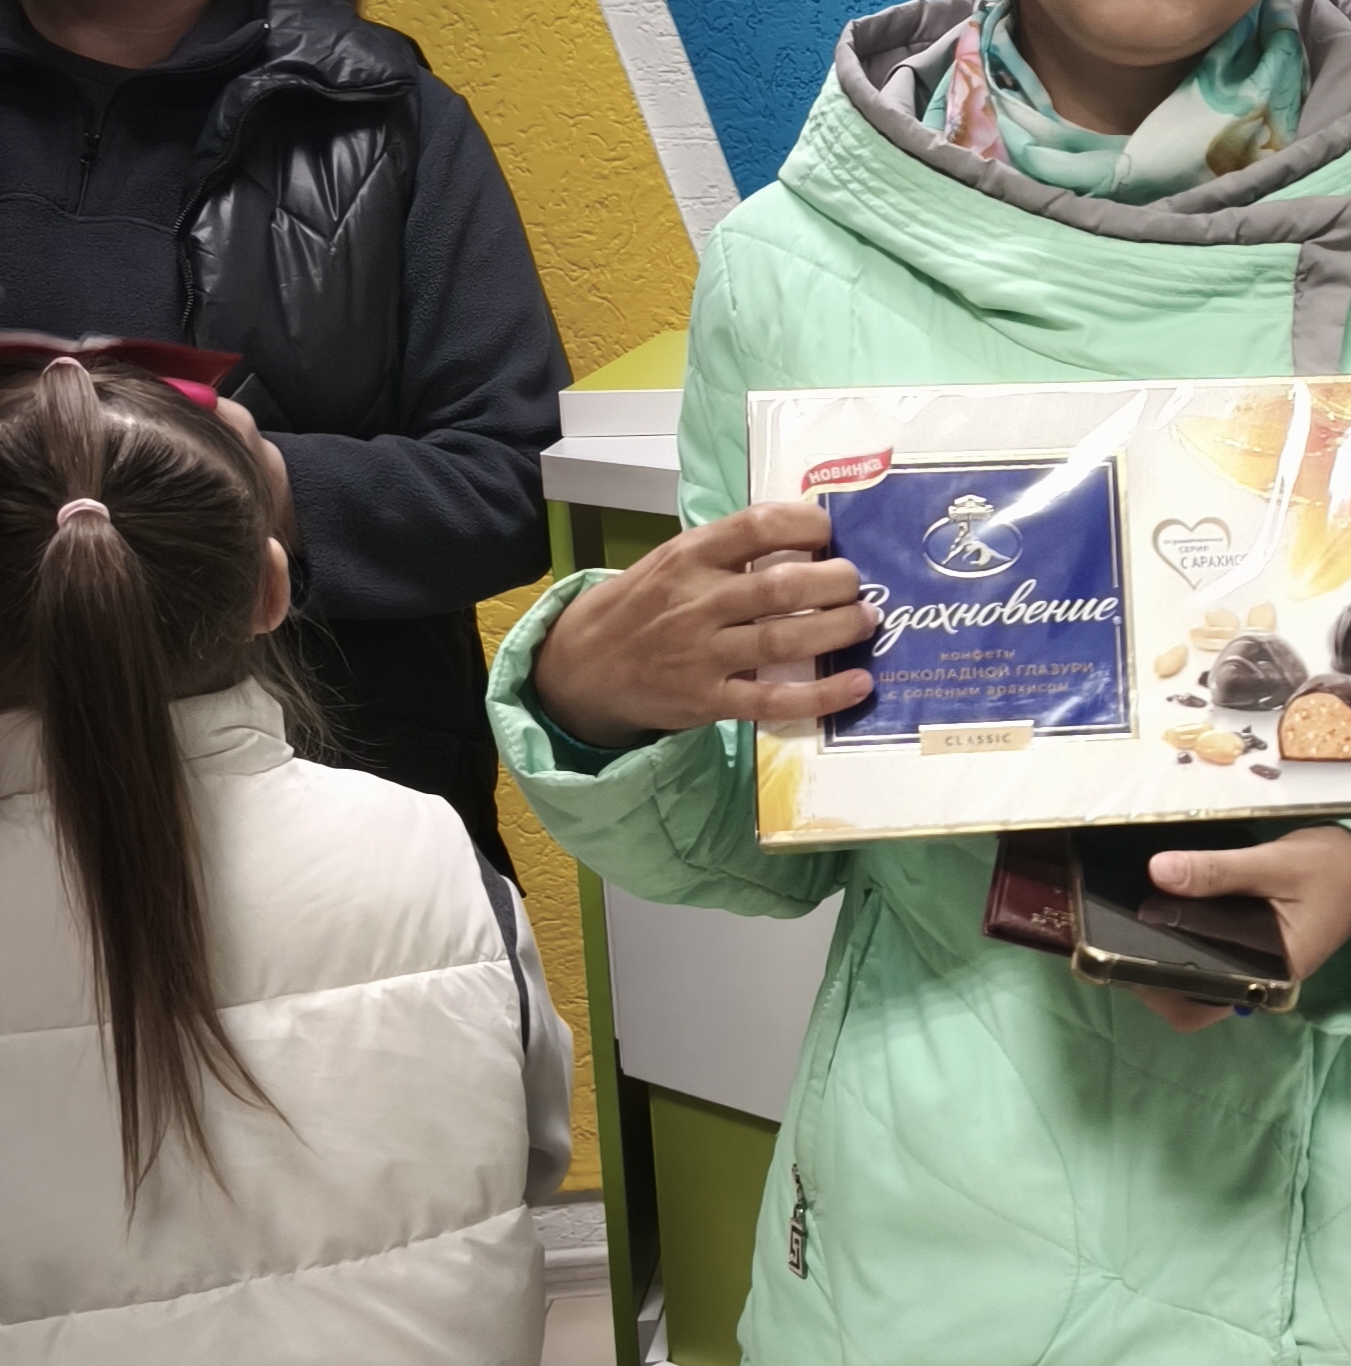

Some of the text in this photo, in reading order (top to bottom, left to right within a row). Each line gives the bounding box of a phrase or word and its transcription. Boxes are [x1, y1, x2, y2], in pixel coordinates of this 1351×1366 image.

[1192, 553, 1248, 568] АРАХИС
[858, 578, 1119, 657] Вдохновение
[939, 648, 1016, 662] конфеты
[880, 662, 1094, 683] ШОКОЛАДНОЙ ГЛАЗУРИ
[944, 732, 1011, 746] CLASSIC
